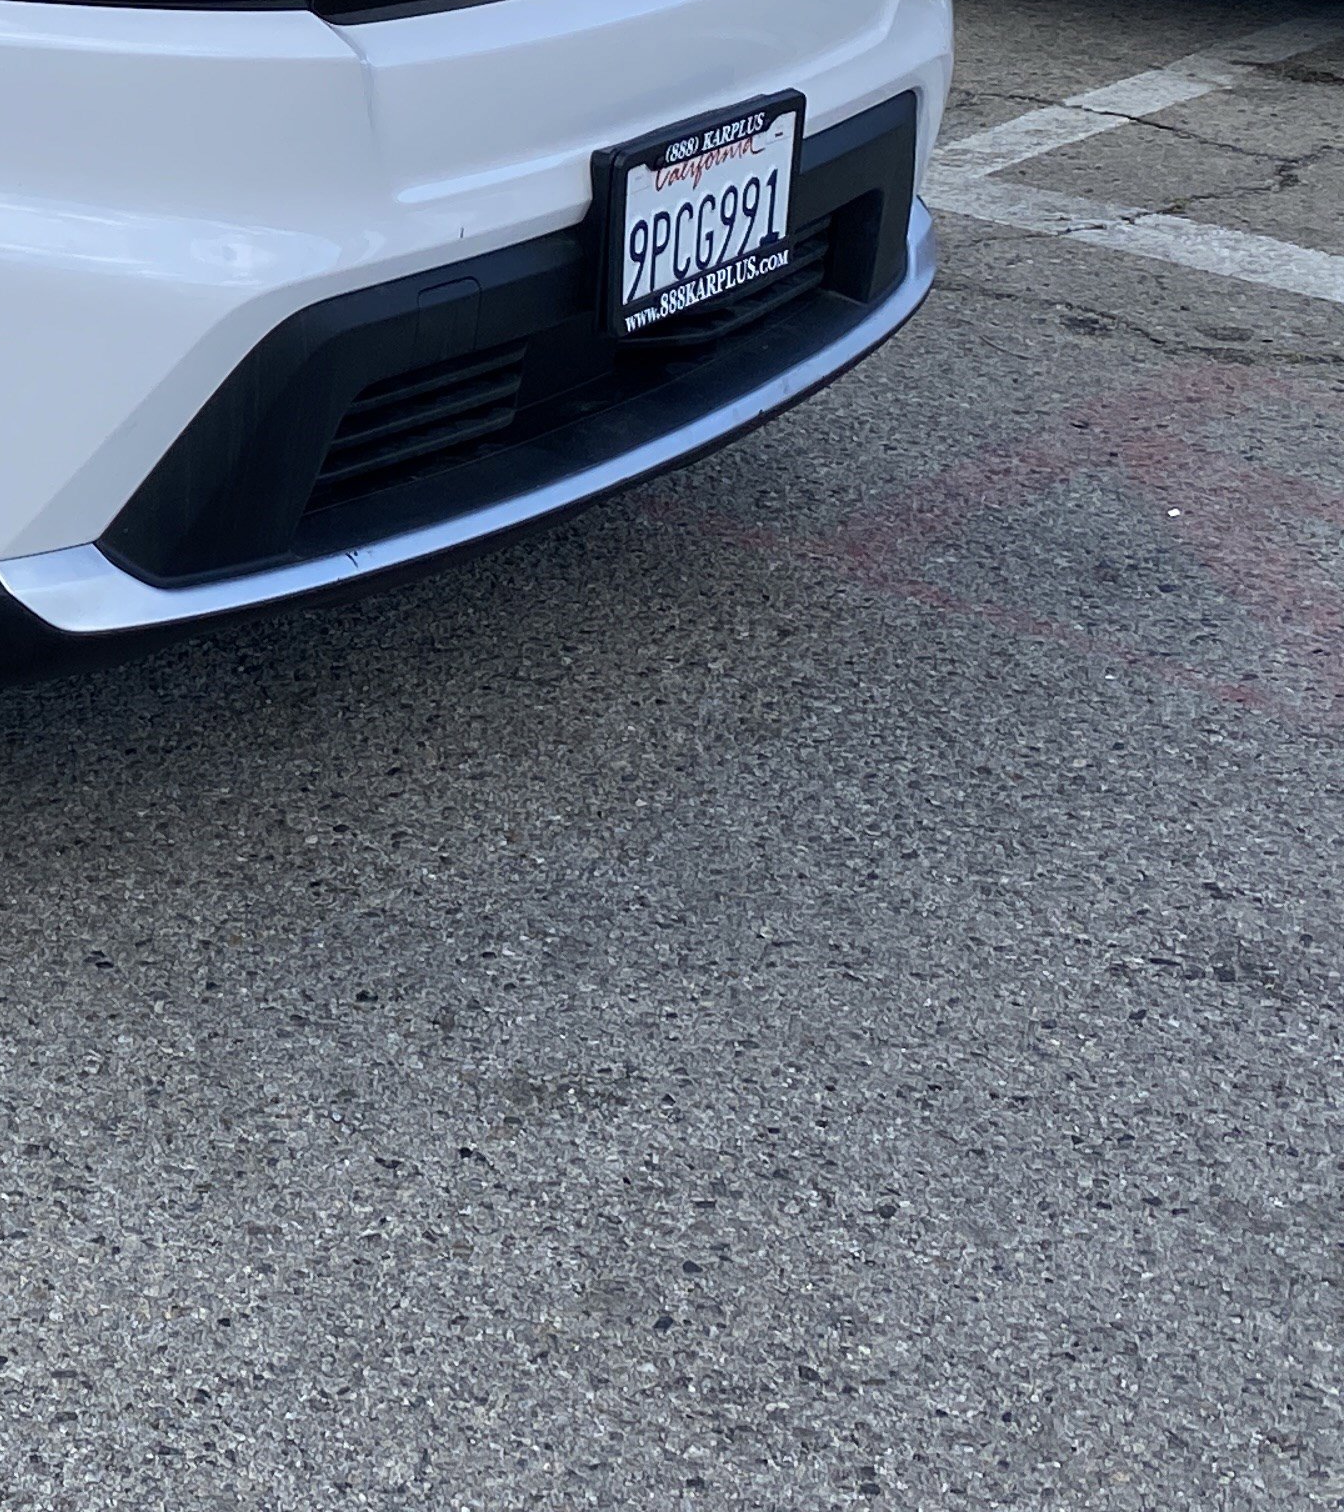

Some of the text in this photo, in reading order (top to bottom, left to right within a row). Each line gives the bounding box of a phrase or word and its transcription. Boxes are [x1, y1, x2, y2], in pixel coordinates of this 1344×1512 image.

[665, 112, 765, 163] (888) KARPLUS
[627, 168, 780, 303] 9PCG991
